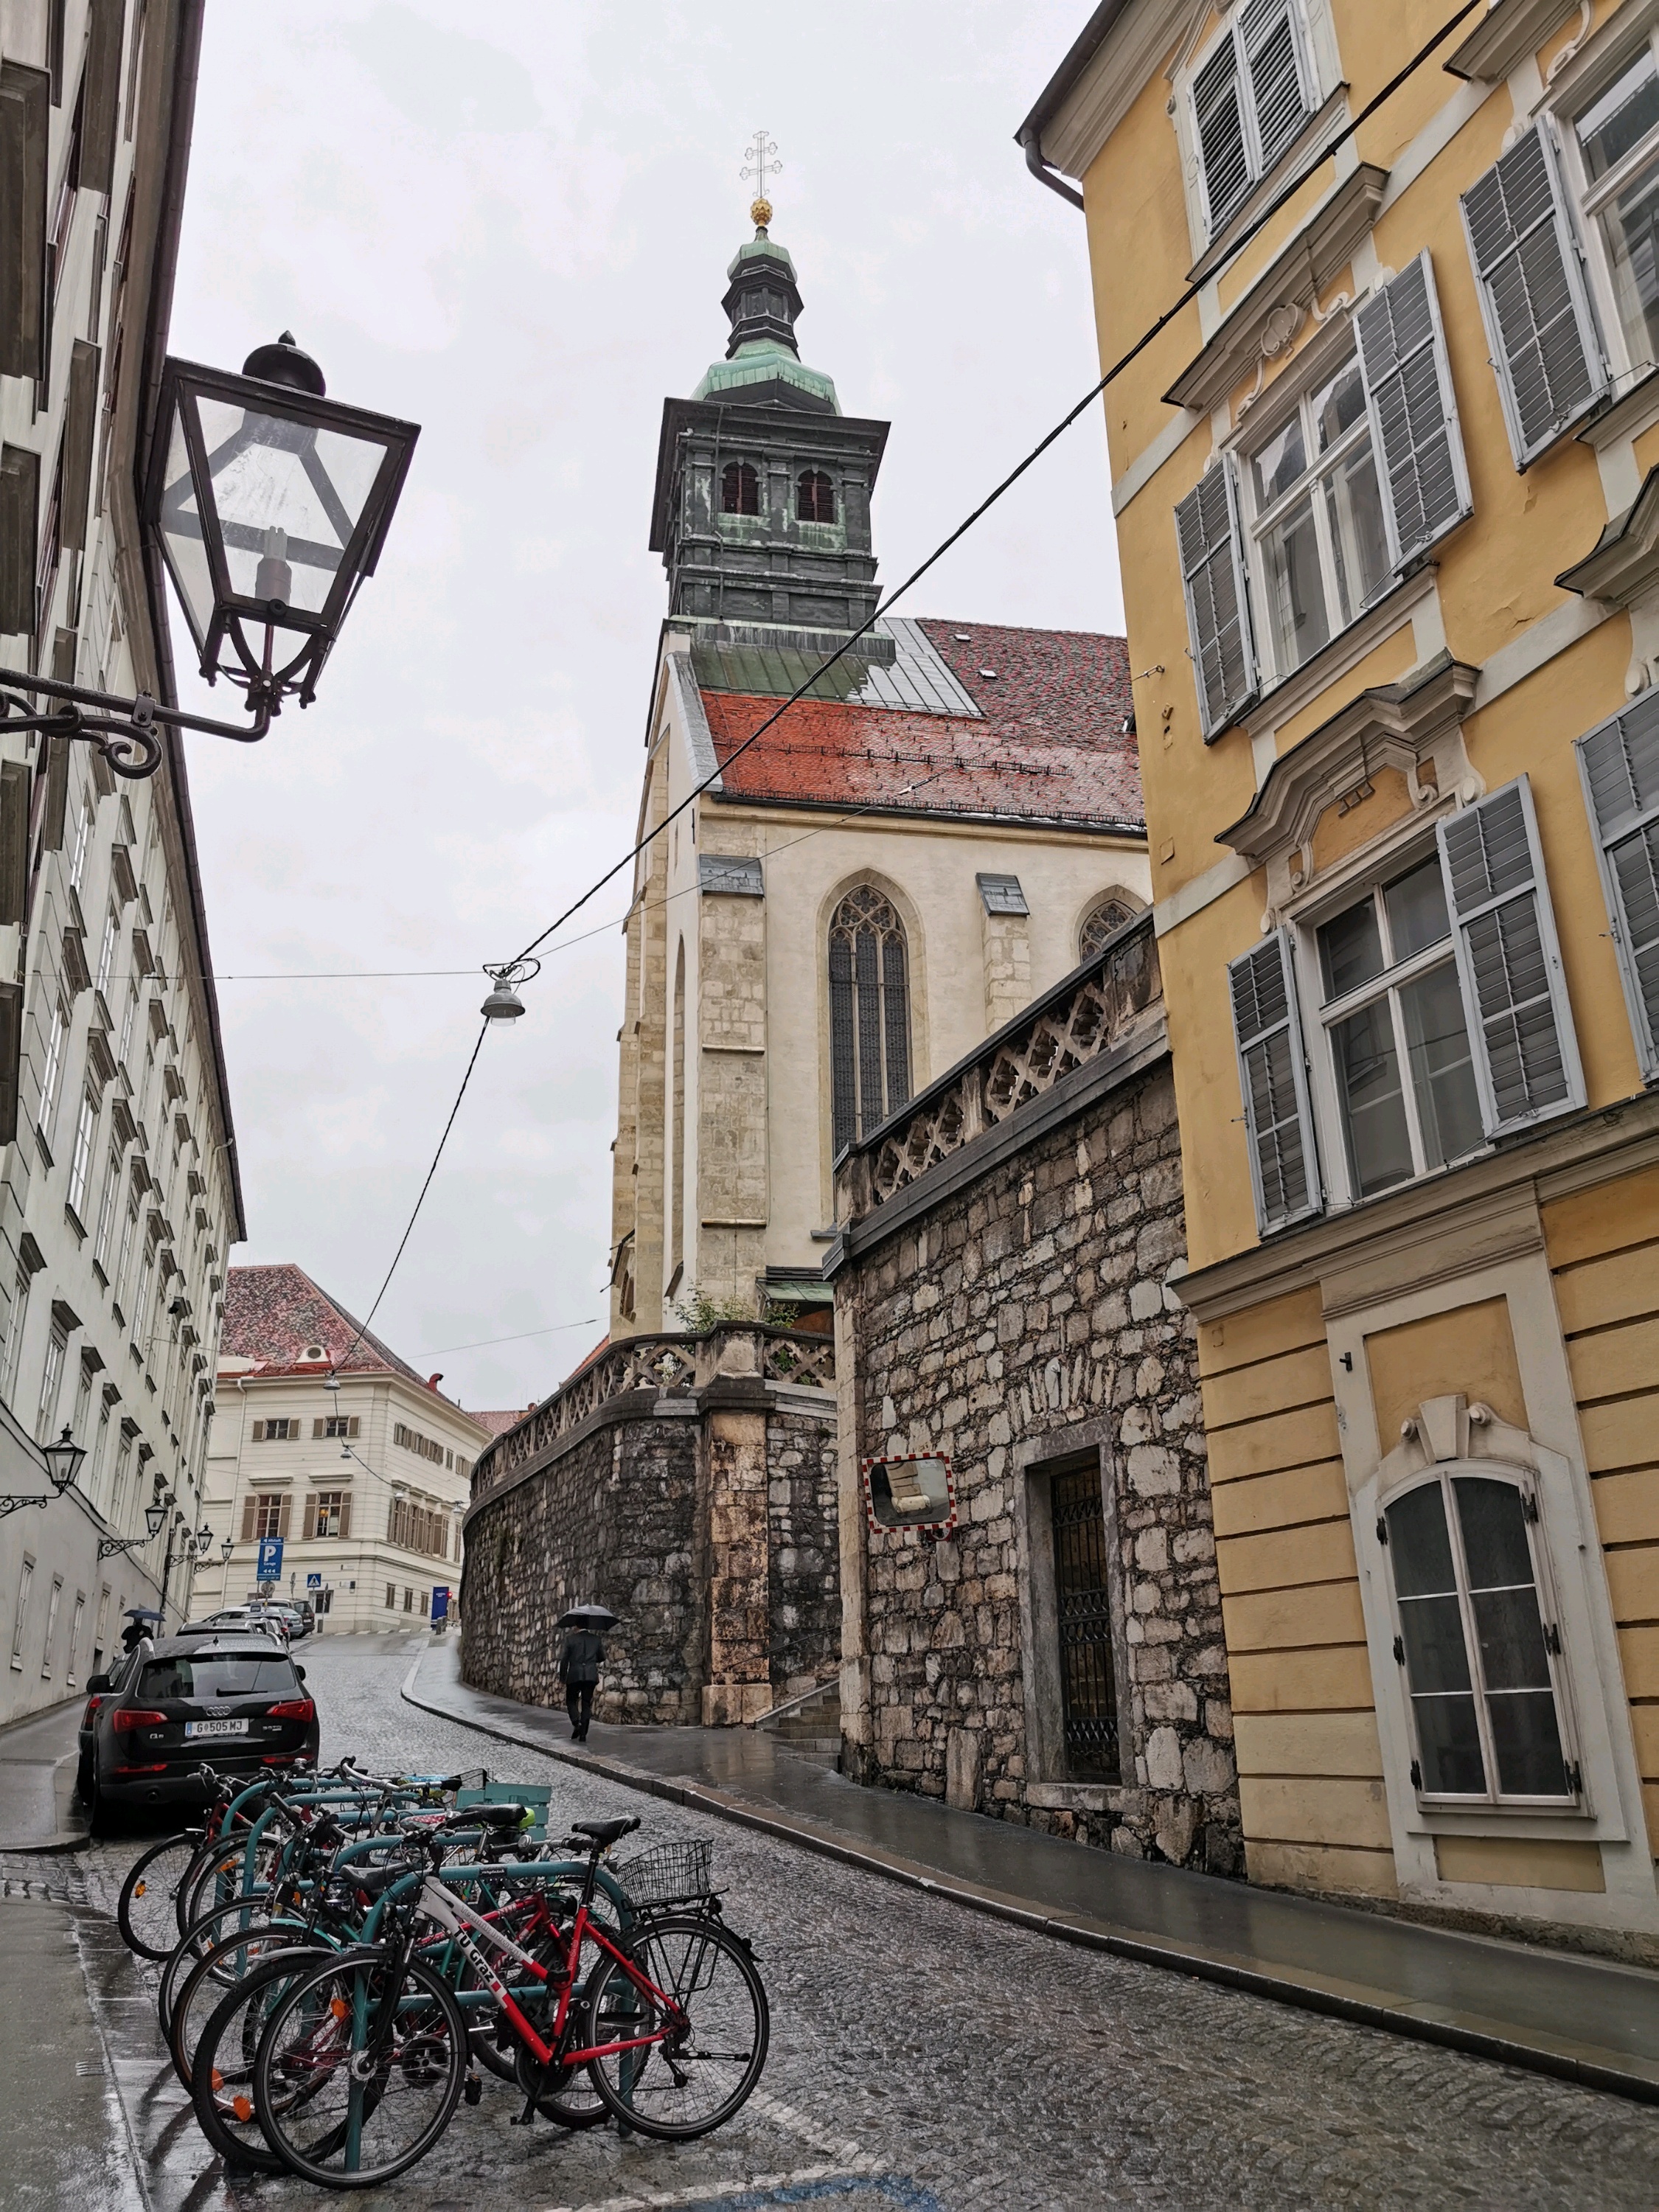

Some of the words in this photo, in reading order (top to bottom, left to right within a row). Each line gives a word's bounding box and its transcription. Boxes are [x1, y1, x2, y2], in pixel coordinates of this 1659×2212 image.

[263, 1545, 276, 1562] P
[209, 1722, 228, 1732] 505
[229, 1720, 243, 1731] MJ
[453, 1926, 471, 1948] TU
[469, 1949, 494, 1982] Graz
